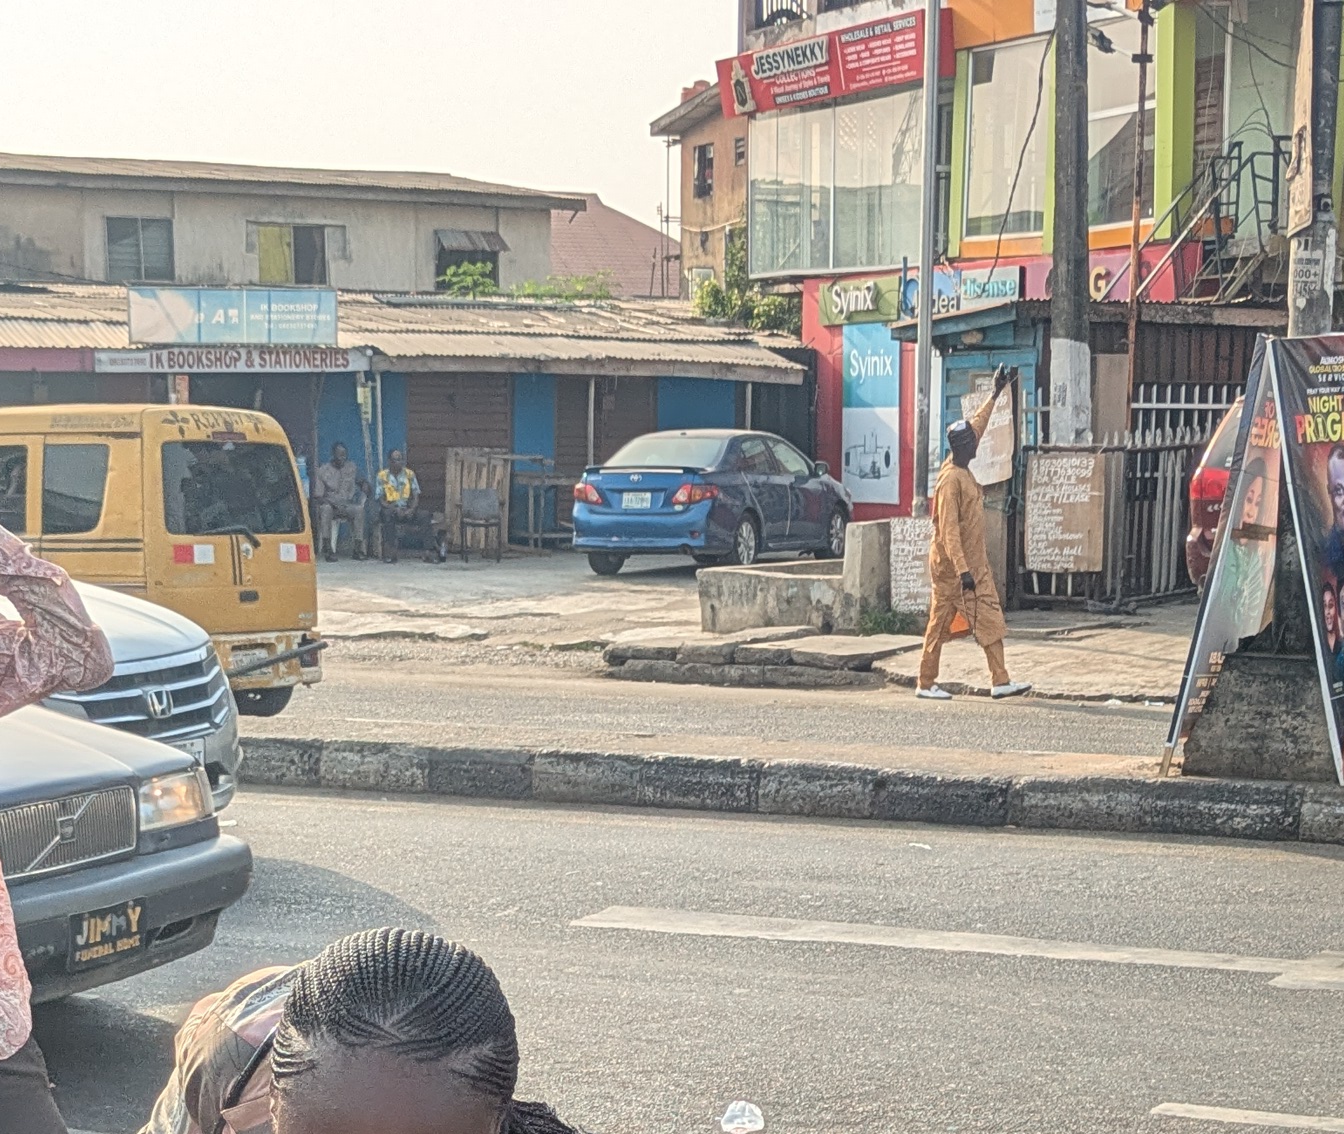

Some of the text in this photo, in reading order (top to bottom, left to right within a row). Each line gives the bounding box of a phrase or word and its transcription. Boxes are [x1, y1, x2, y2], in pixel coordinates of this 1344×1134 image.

[892, 16, 916, 31] SERVICES
[753, 39, 827, 77] JESSYNEKKY
[270, 303, 319, 313] BOOKSHOP
[831, 284, 876, 319] Syinix
[167, 350, 242, 370] BOOKSHOP
[245, 351, 255, 369] &
[258, 349, 350, 370] STATIONERIES
[849, 349, 893, 384] Syinix
[1307, 394, 1344, 414] NIGHT
[75, 905, 142, 946] JIMMY
[74, 942, 115, 962] FUNERAL
